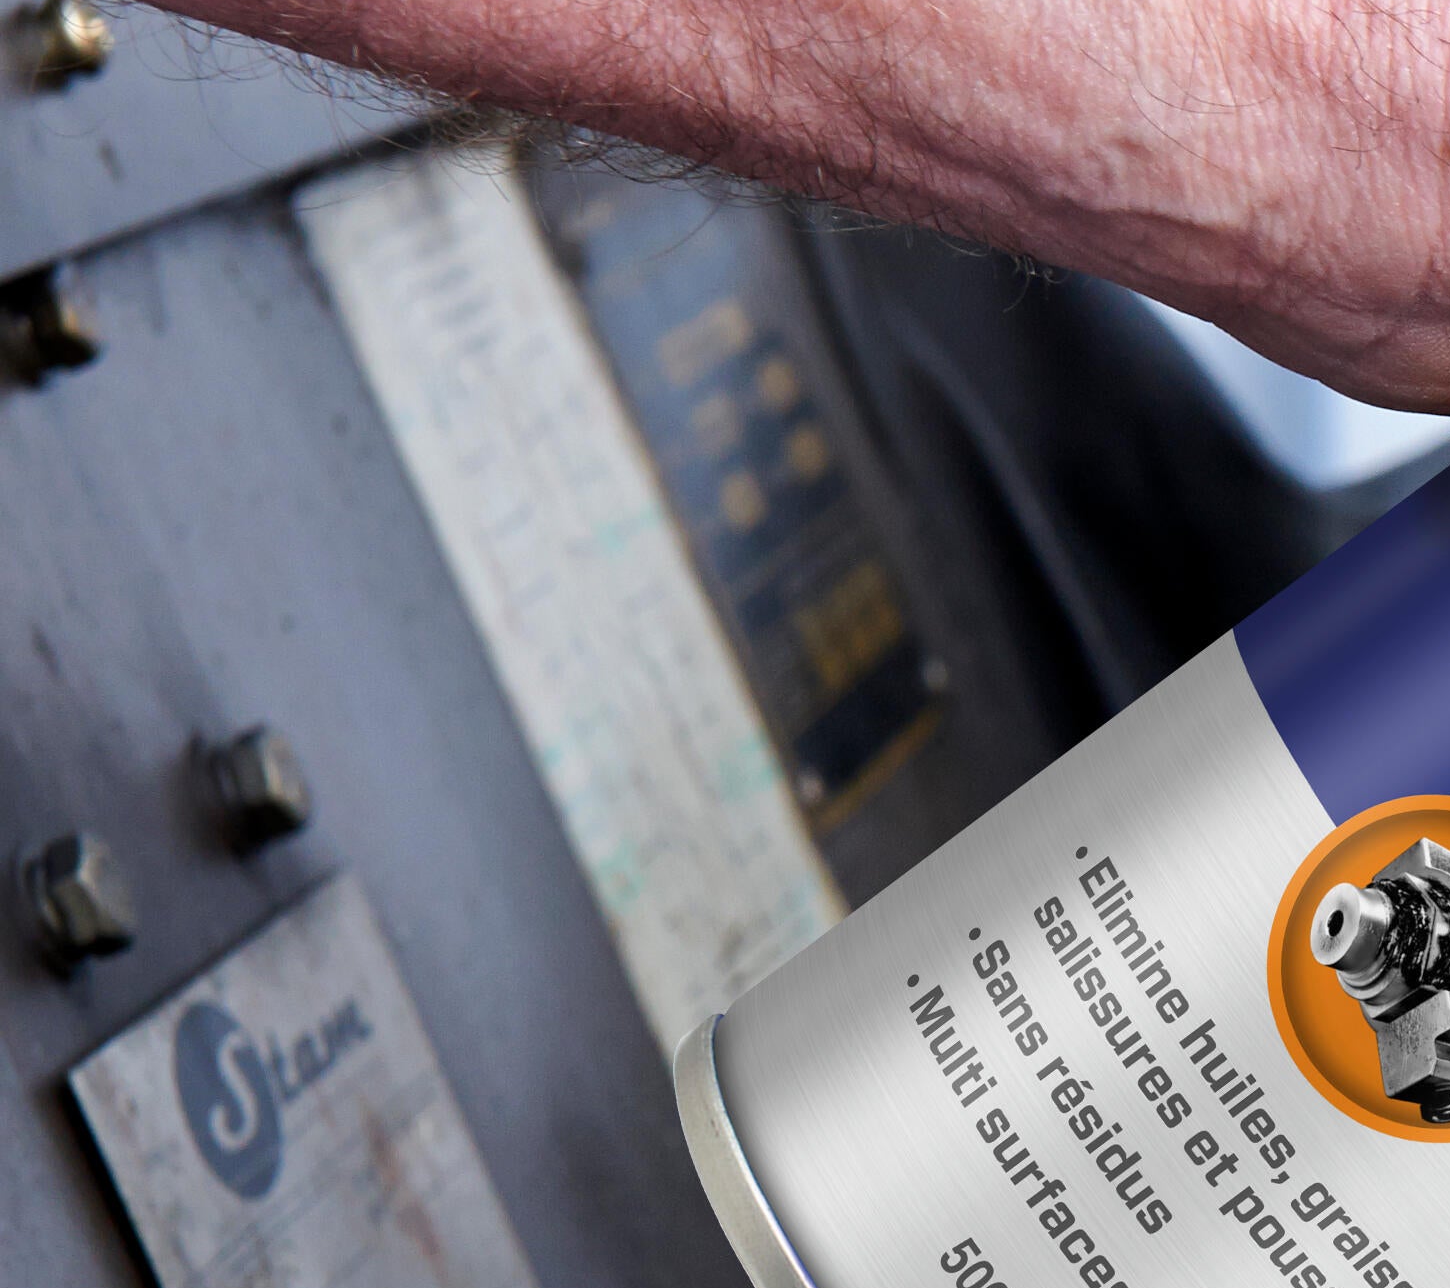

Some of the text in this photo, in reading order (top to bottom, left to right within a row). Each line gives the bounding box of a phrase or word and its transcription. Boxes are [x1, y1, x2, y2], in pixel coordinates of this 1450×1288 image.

[909, 984, 997, 1108] Multi
[972, 939, 1173, 1235] Sans résidus
[1033, 896, 1192, 1129] salissures
[1184, 1130, 1239, 1188] et
[1078, 856, 1190, 1024] Elimine
[1179, 1018, 1296, 1185] huiles,
